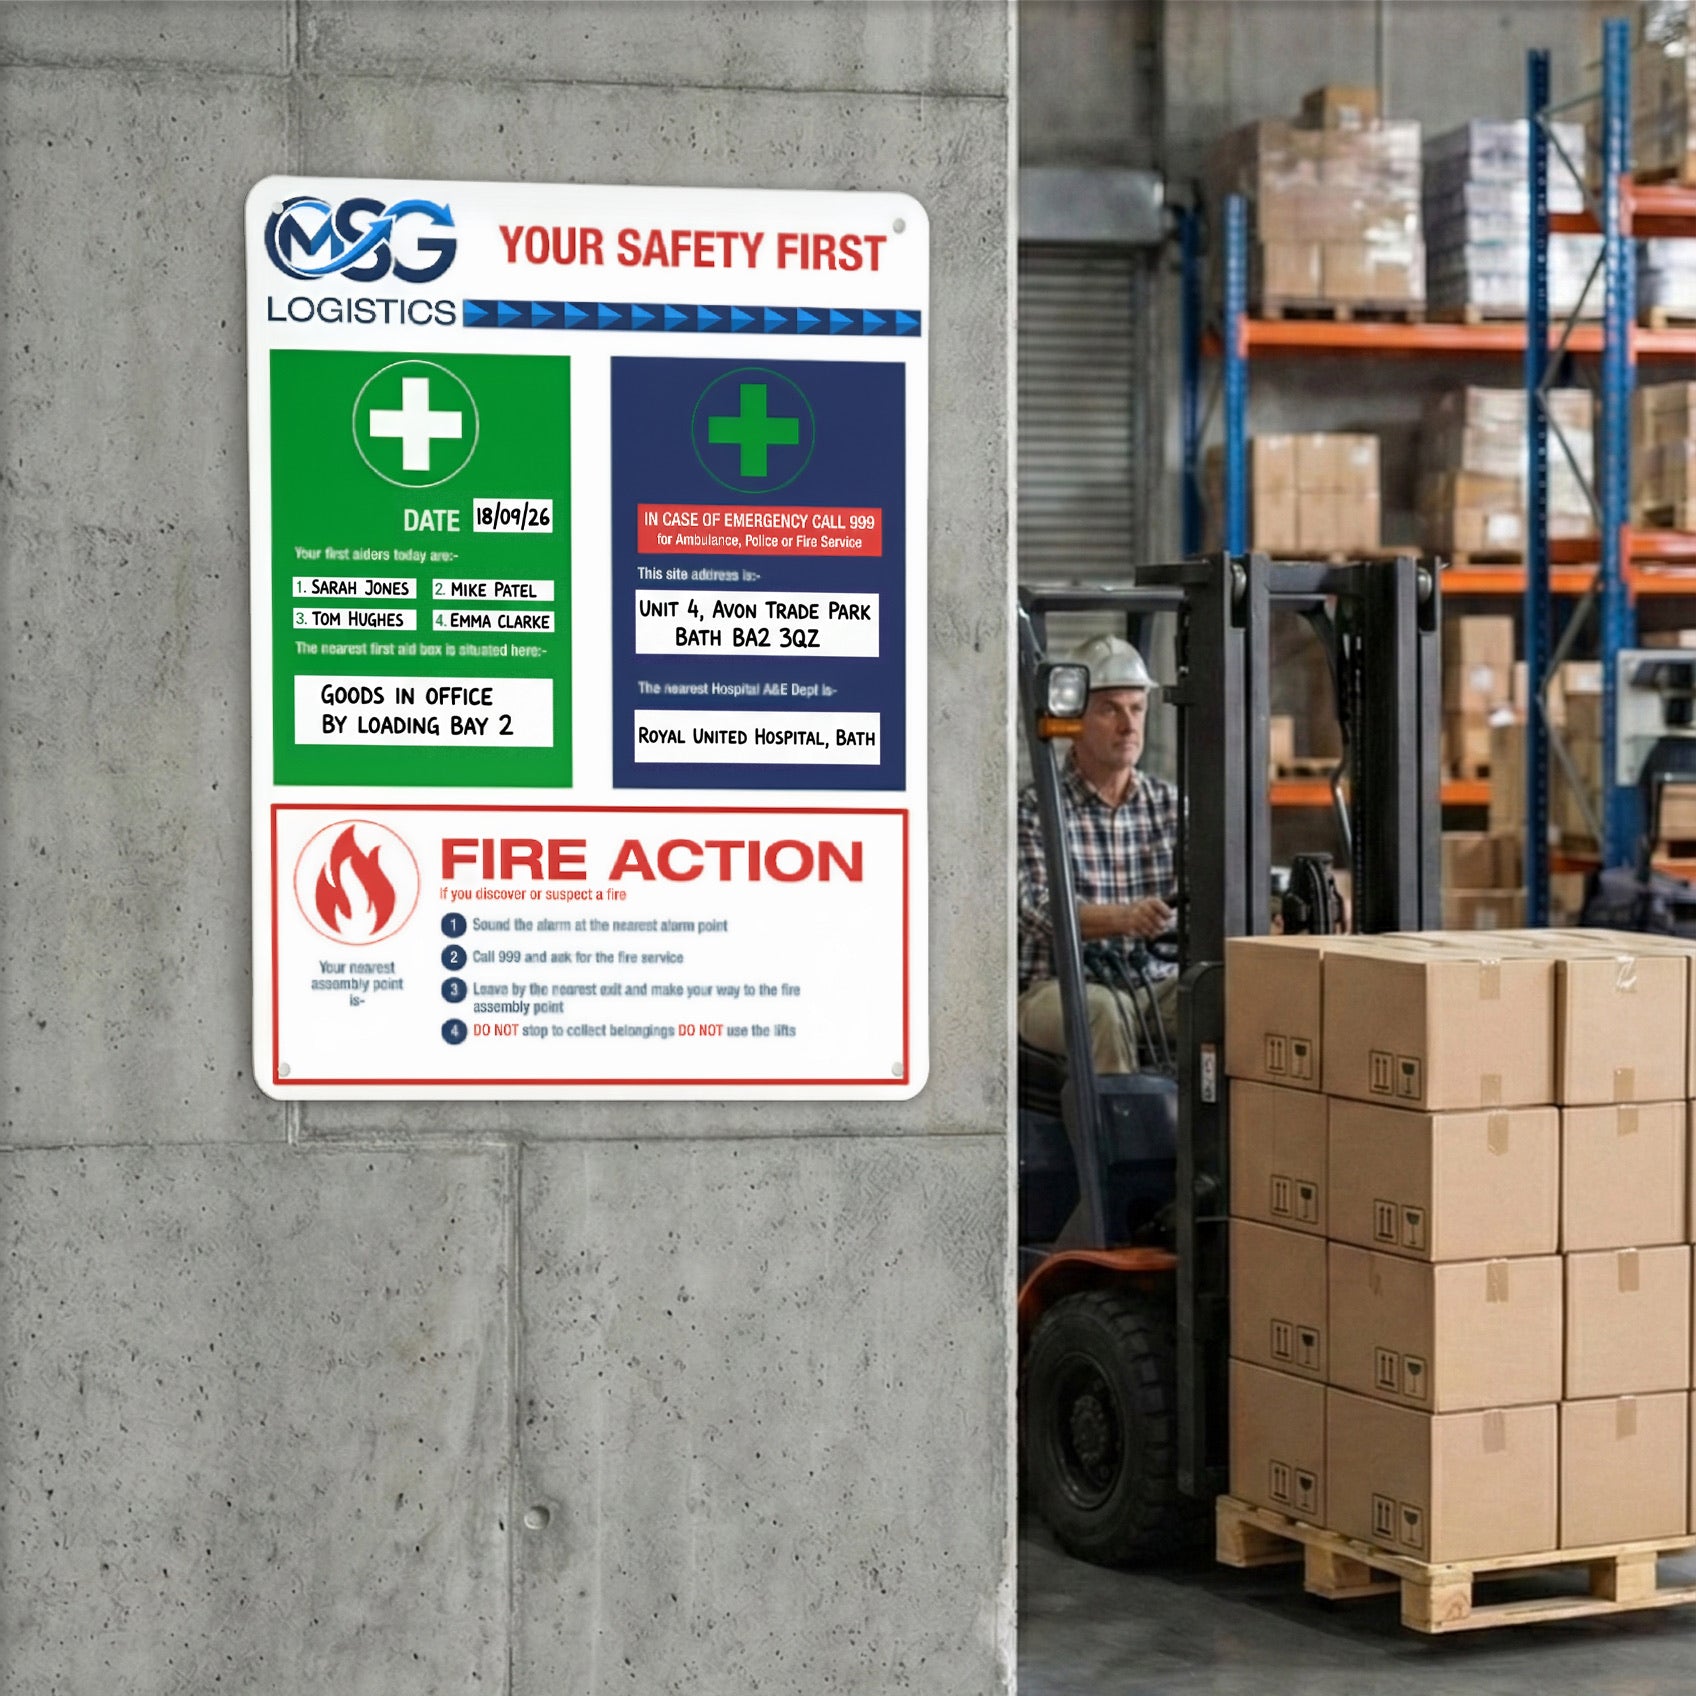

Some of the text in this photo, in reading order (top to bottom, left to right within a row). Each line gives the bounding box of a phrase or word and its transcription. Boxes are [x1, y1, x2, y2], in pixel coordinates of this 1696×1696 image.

[499, 225, 887, 272] YOUR SAFETY FIRST
[267, 296, 457, 325] LOGISTICS
[404, 502, 550, 531] DATE 18/09/26
[645, 512, 875, 529] IN CASE OF EMERGENCY CALL 999
[657, 534, 862, 548] for Ambulance, Police or Fire Service
[295, 547, 321, 560] Your
[325, 547, 350, 560] first
[353, 548, 389, 561] aiders
[394, 549, 426, 563] today
[638, 567, 662, 579] This
[666, 568, 688, 580] site
[692, 569, 739, 581] address
[296, 579, 409, 595] 1. SARAH JONES
[435, 582, 537, 597] 2. MIKE PATEL
[640, 599, 871, 621] UNIT 4, AVON TRADE PARK
[296, 611, 403, 627] 3. TOM HUGHES
[436, 613, 550, 629] 4. EMMA CLARKE
[676, 627, 820, 648] BATH BA2 3QZ
[295, 642, 317, 654] The
[321, 643, 367, 655] nearest
[371, 643, 394, 655] first
[398, 643, 416, 656] aid
[420, 643, 442, 656] box
[445, 644, 455, 656] is
[459, 644, 507, 656] situated
[321, 684, 493, 705] GOODS IN OFFICE
[638, 681, 661, 694] The
[665, 682, 708, 694] nearest
[712, 683, 759, 697] Hospital
[763, 683, 787, 696] A&E
[792, 683, 818, 698] Dept
[322, 714, 513, 735] BY LOADING BAY 2
[639, 727, 875, 749] ROYAL UNITED HOSPITAL, BATH
[442, 838, 863, 882] FIRE ACTION
[440, 887, 627, 903] If you discover or suspect a fire
[451, 918, 728, 935] 1 Sound the alarm at the nearest alarm point
[450, 951, 683, 964] 2 Call 999 and ask for the fire service
[320, 960, 394, 974] Your nearest
[311, 978, 403, 992] assembly point
[450, 983, 800, 999] 3 Leave by the nearest exit and make your way to the fire
[473, 1001, 564, 1016] assembly point
[450, 1024, 796, 1040] 4 DO NOT stop to collect belongings DO NOT use the lifts
